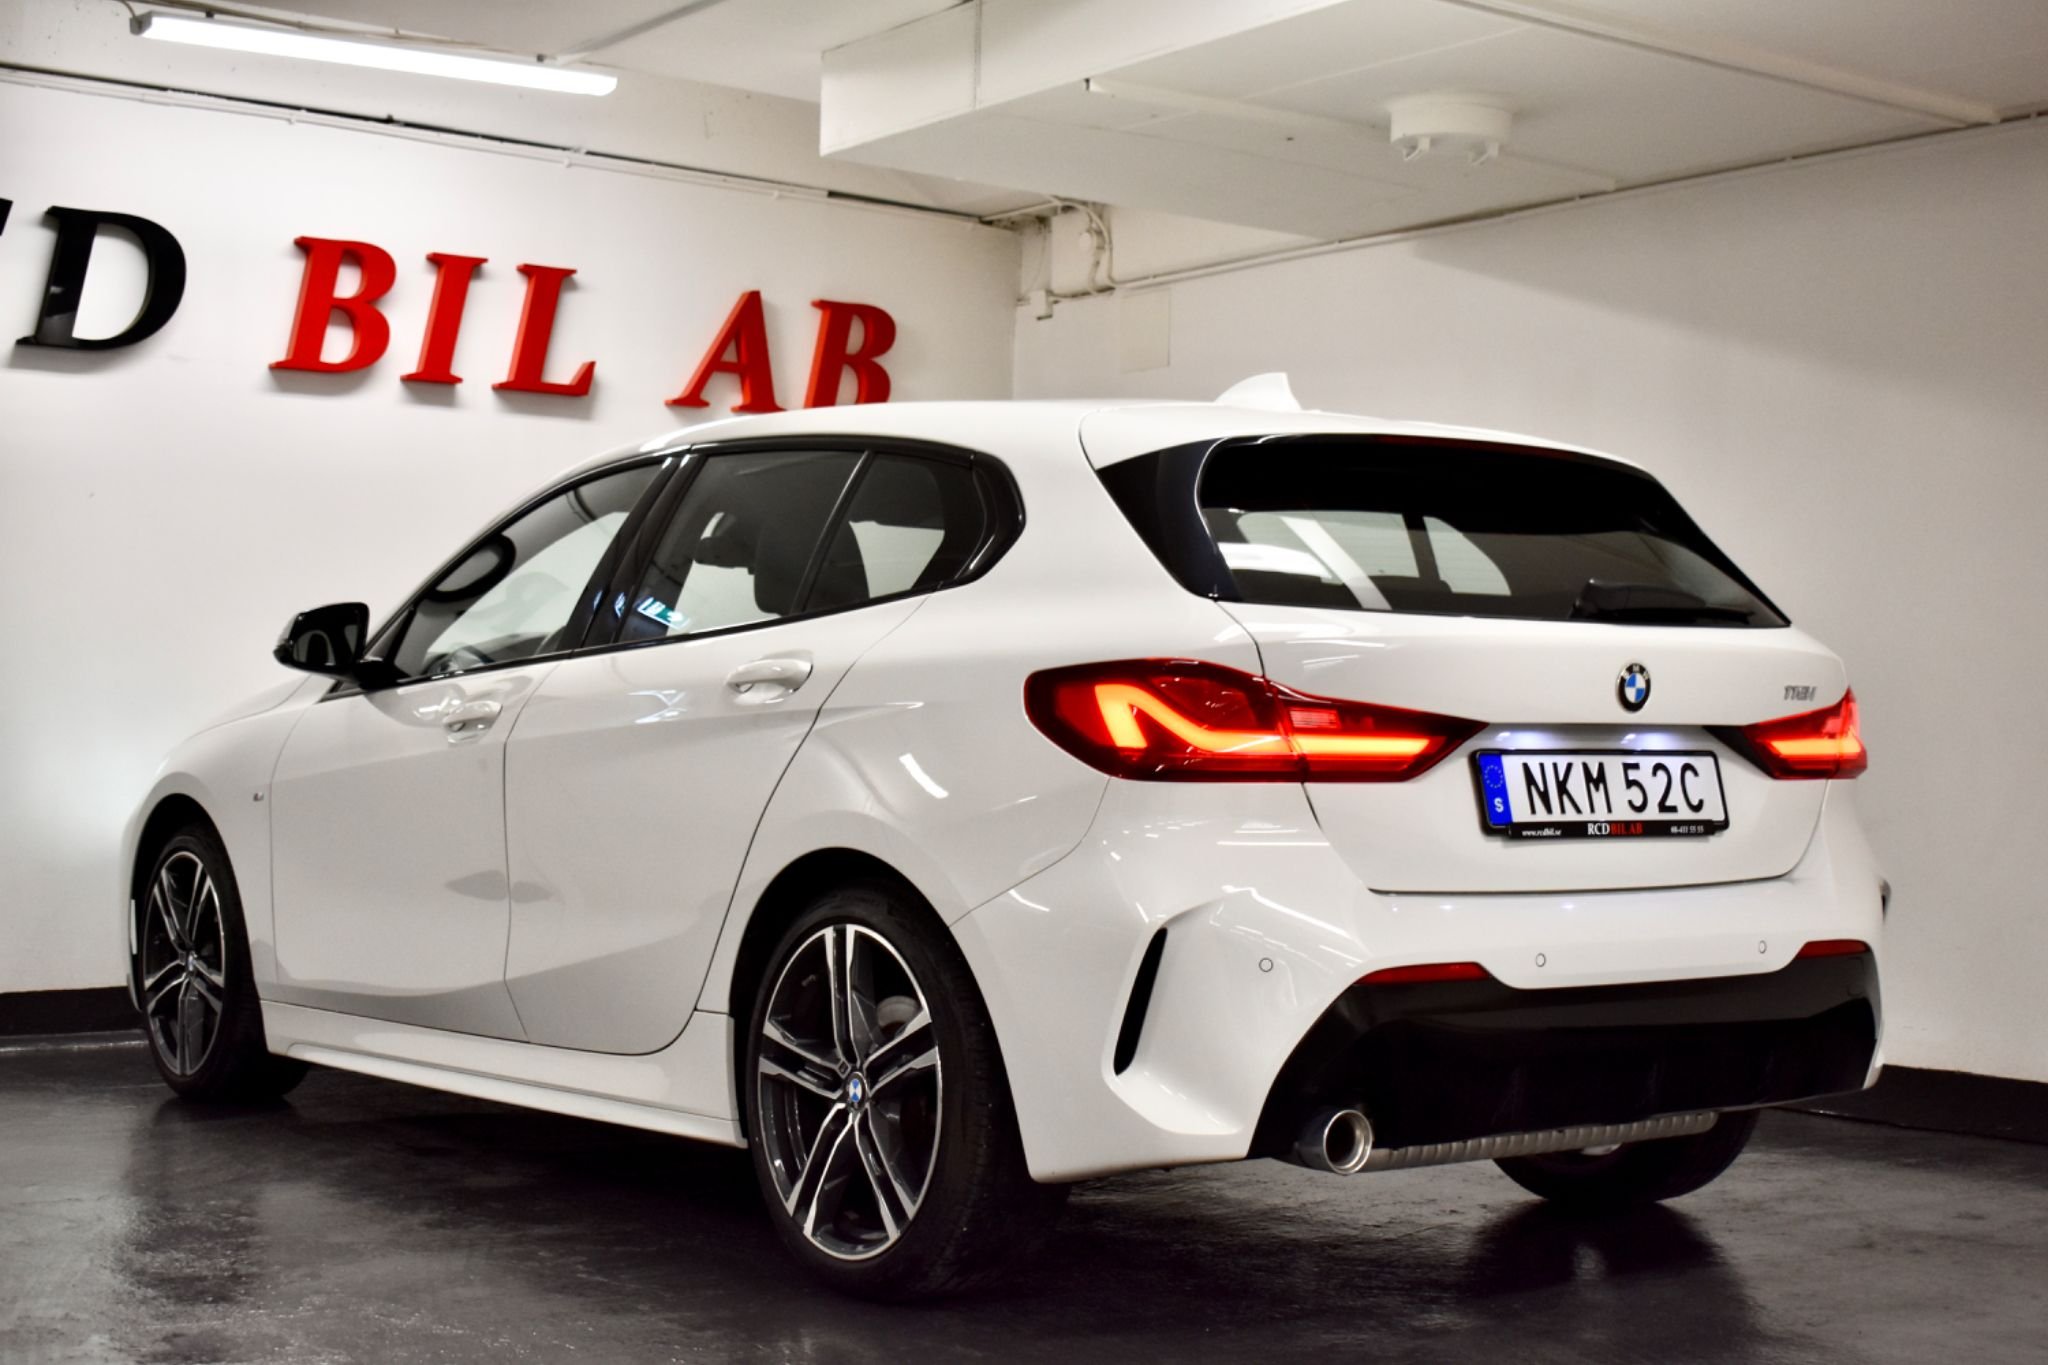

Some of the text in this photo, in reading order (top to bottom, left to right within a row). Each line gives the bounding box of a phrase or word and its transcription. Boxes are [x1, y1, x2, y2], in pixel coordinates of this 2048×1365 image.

[0, 197, 896, 411] D BIL AB
[1494, 798, 1504, 813] S
[1522, 762, 1704, 815] NKM 52C
